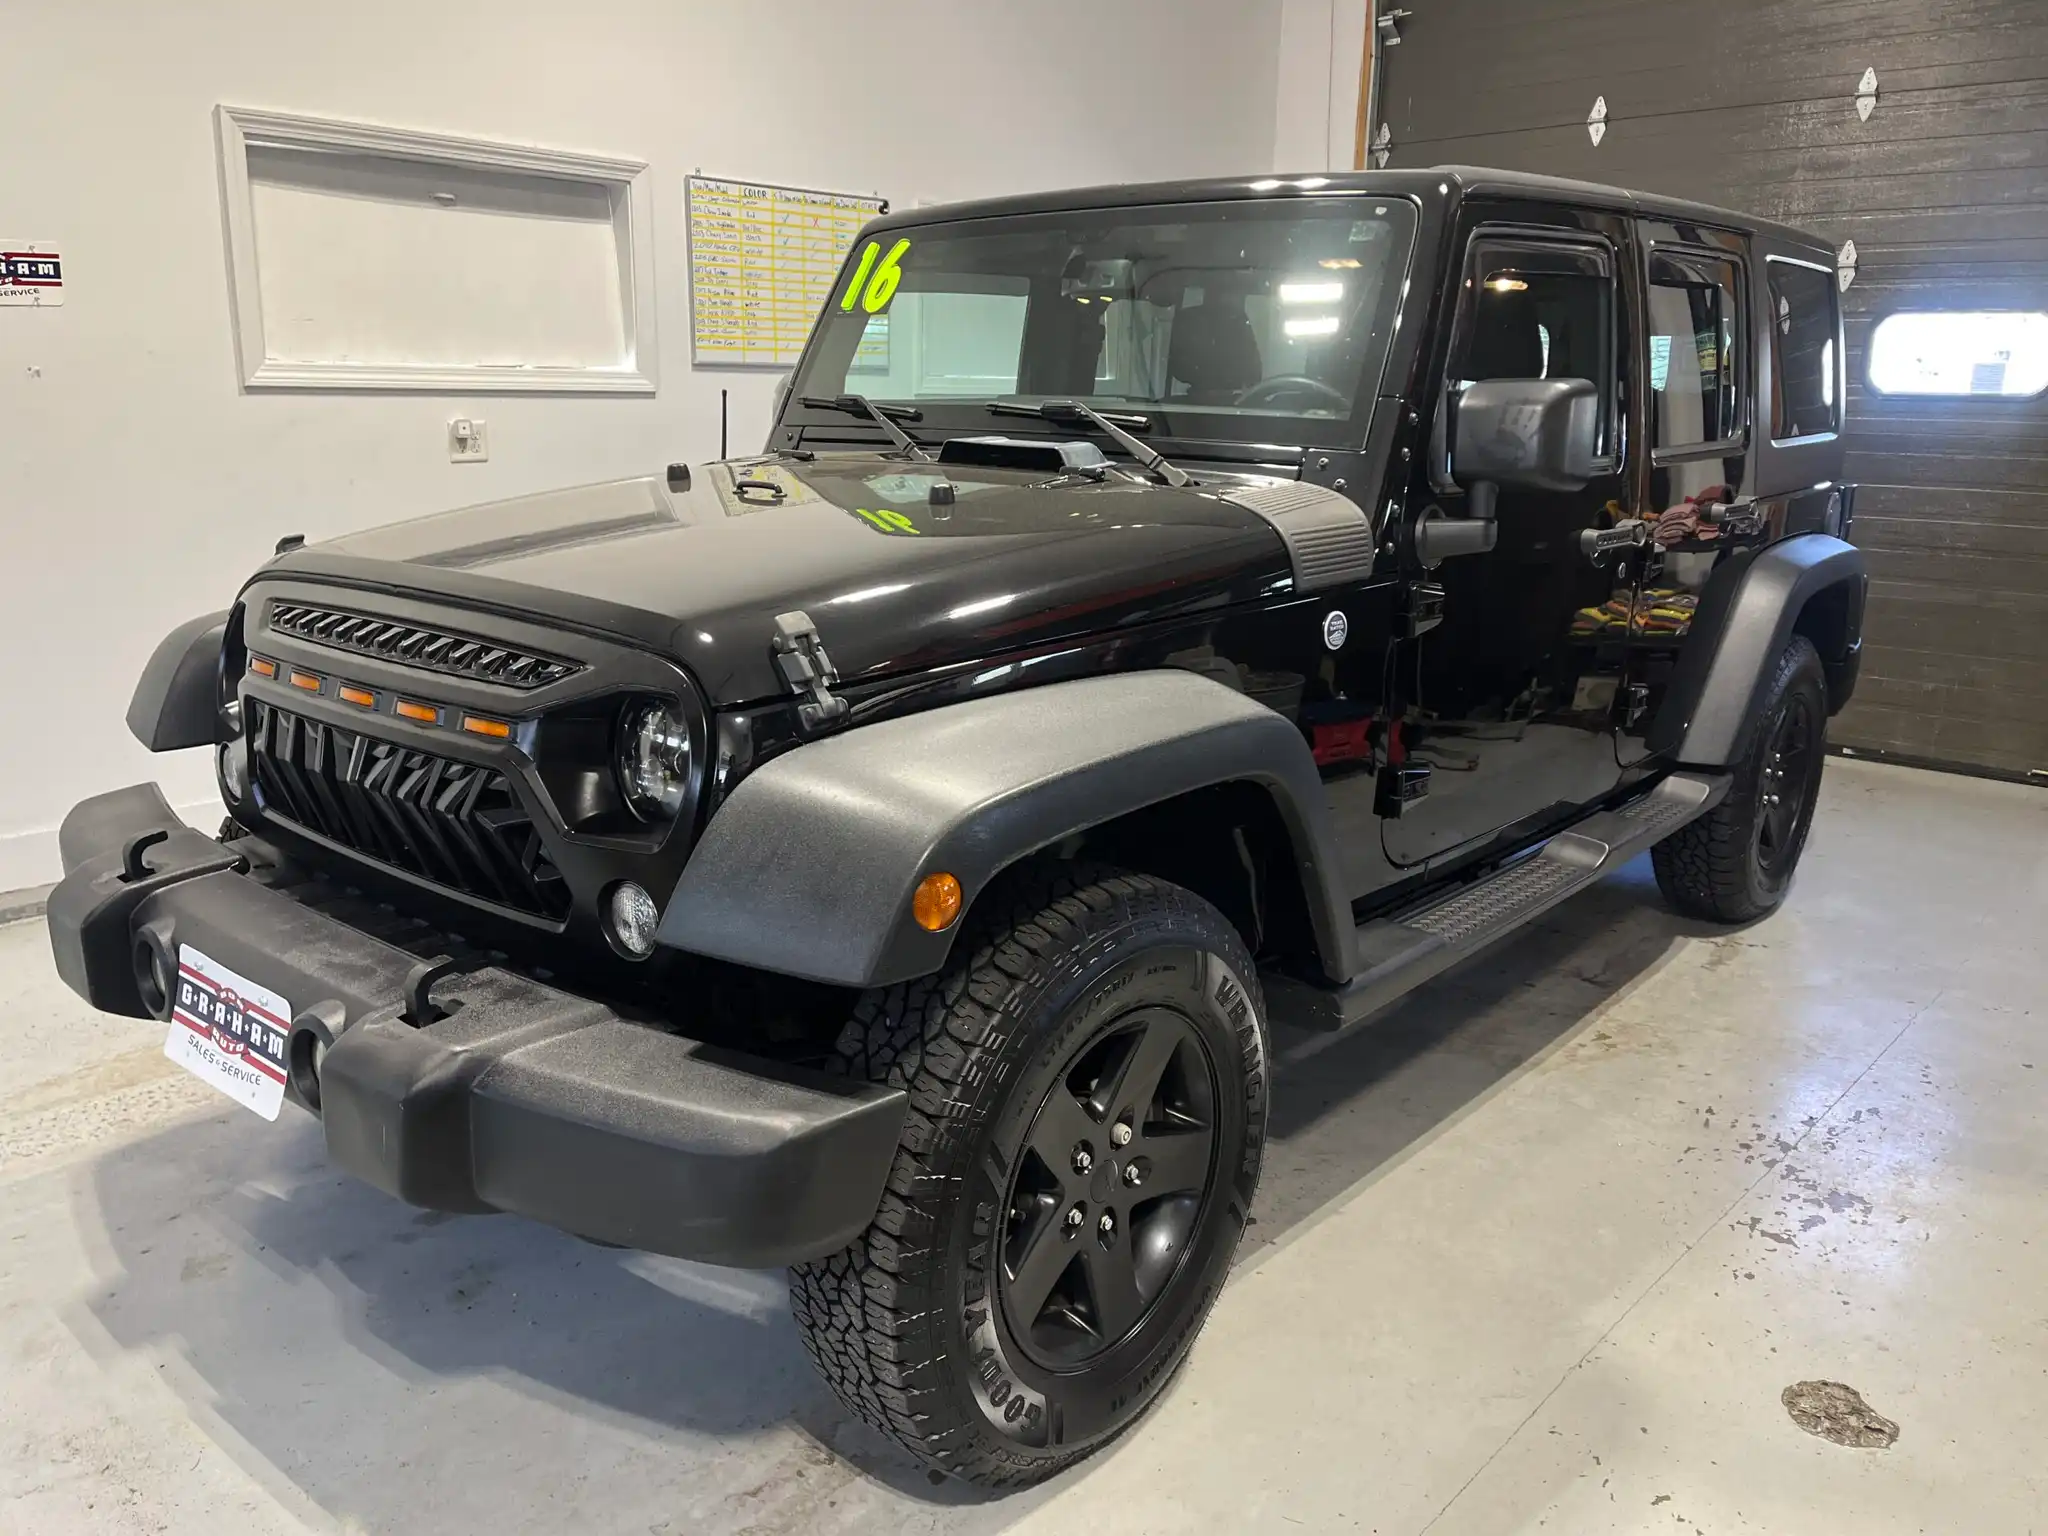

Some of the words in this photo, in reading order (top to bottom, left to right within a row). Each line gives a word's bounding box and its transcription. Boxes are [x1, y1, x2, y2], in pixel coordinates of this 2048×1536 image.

[743, 188, 768, 200] COLOR
[840, 237, 911, 314] 16
[187, 1033, 215, 1064] SALES
[221, 1061, 262, 1086] SERVICE
[211, 1025, 245, 1053] AUTO
[1214, 974, 1264, 1175] WRANGLER
